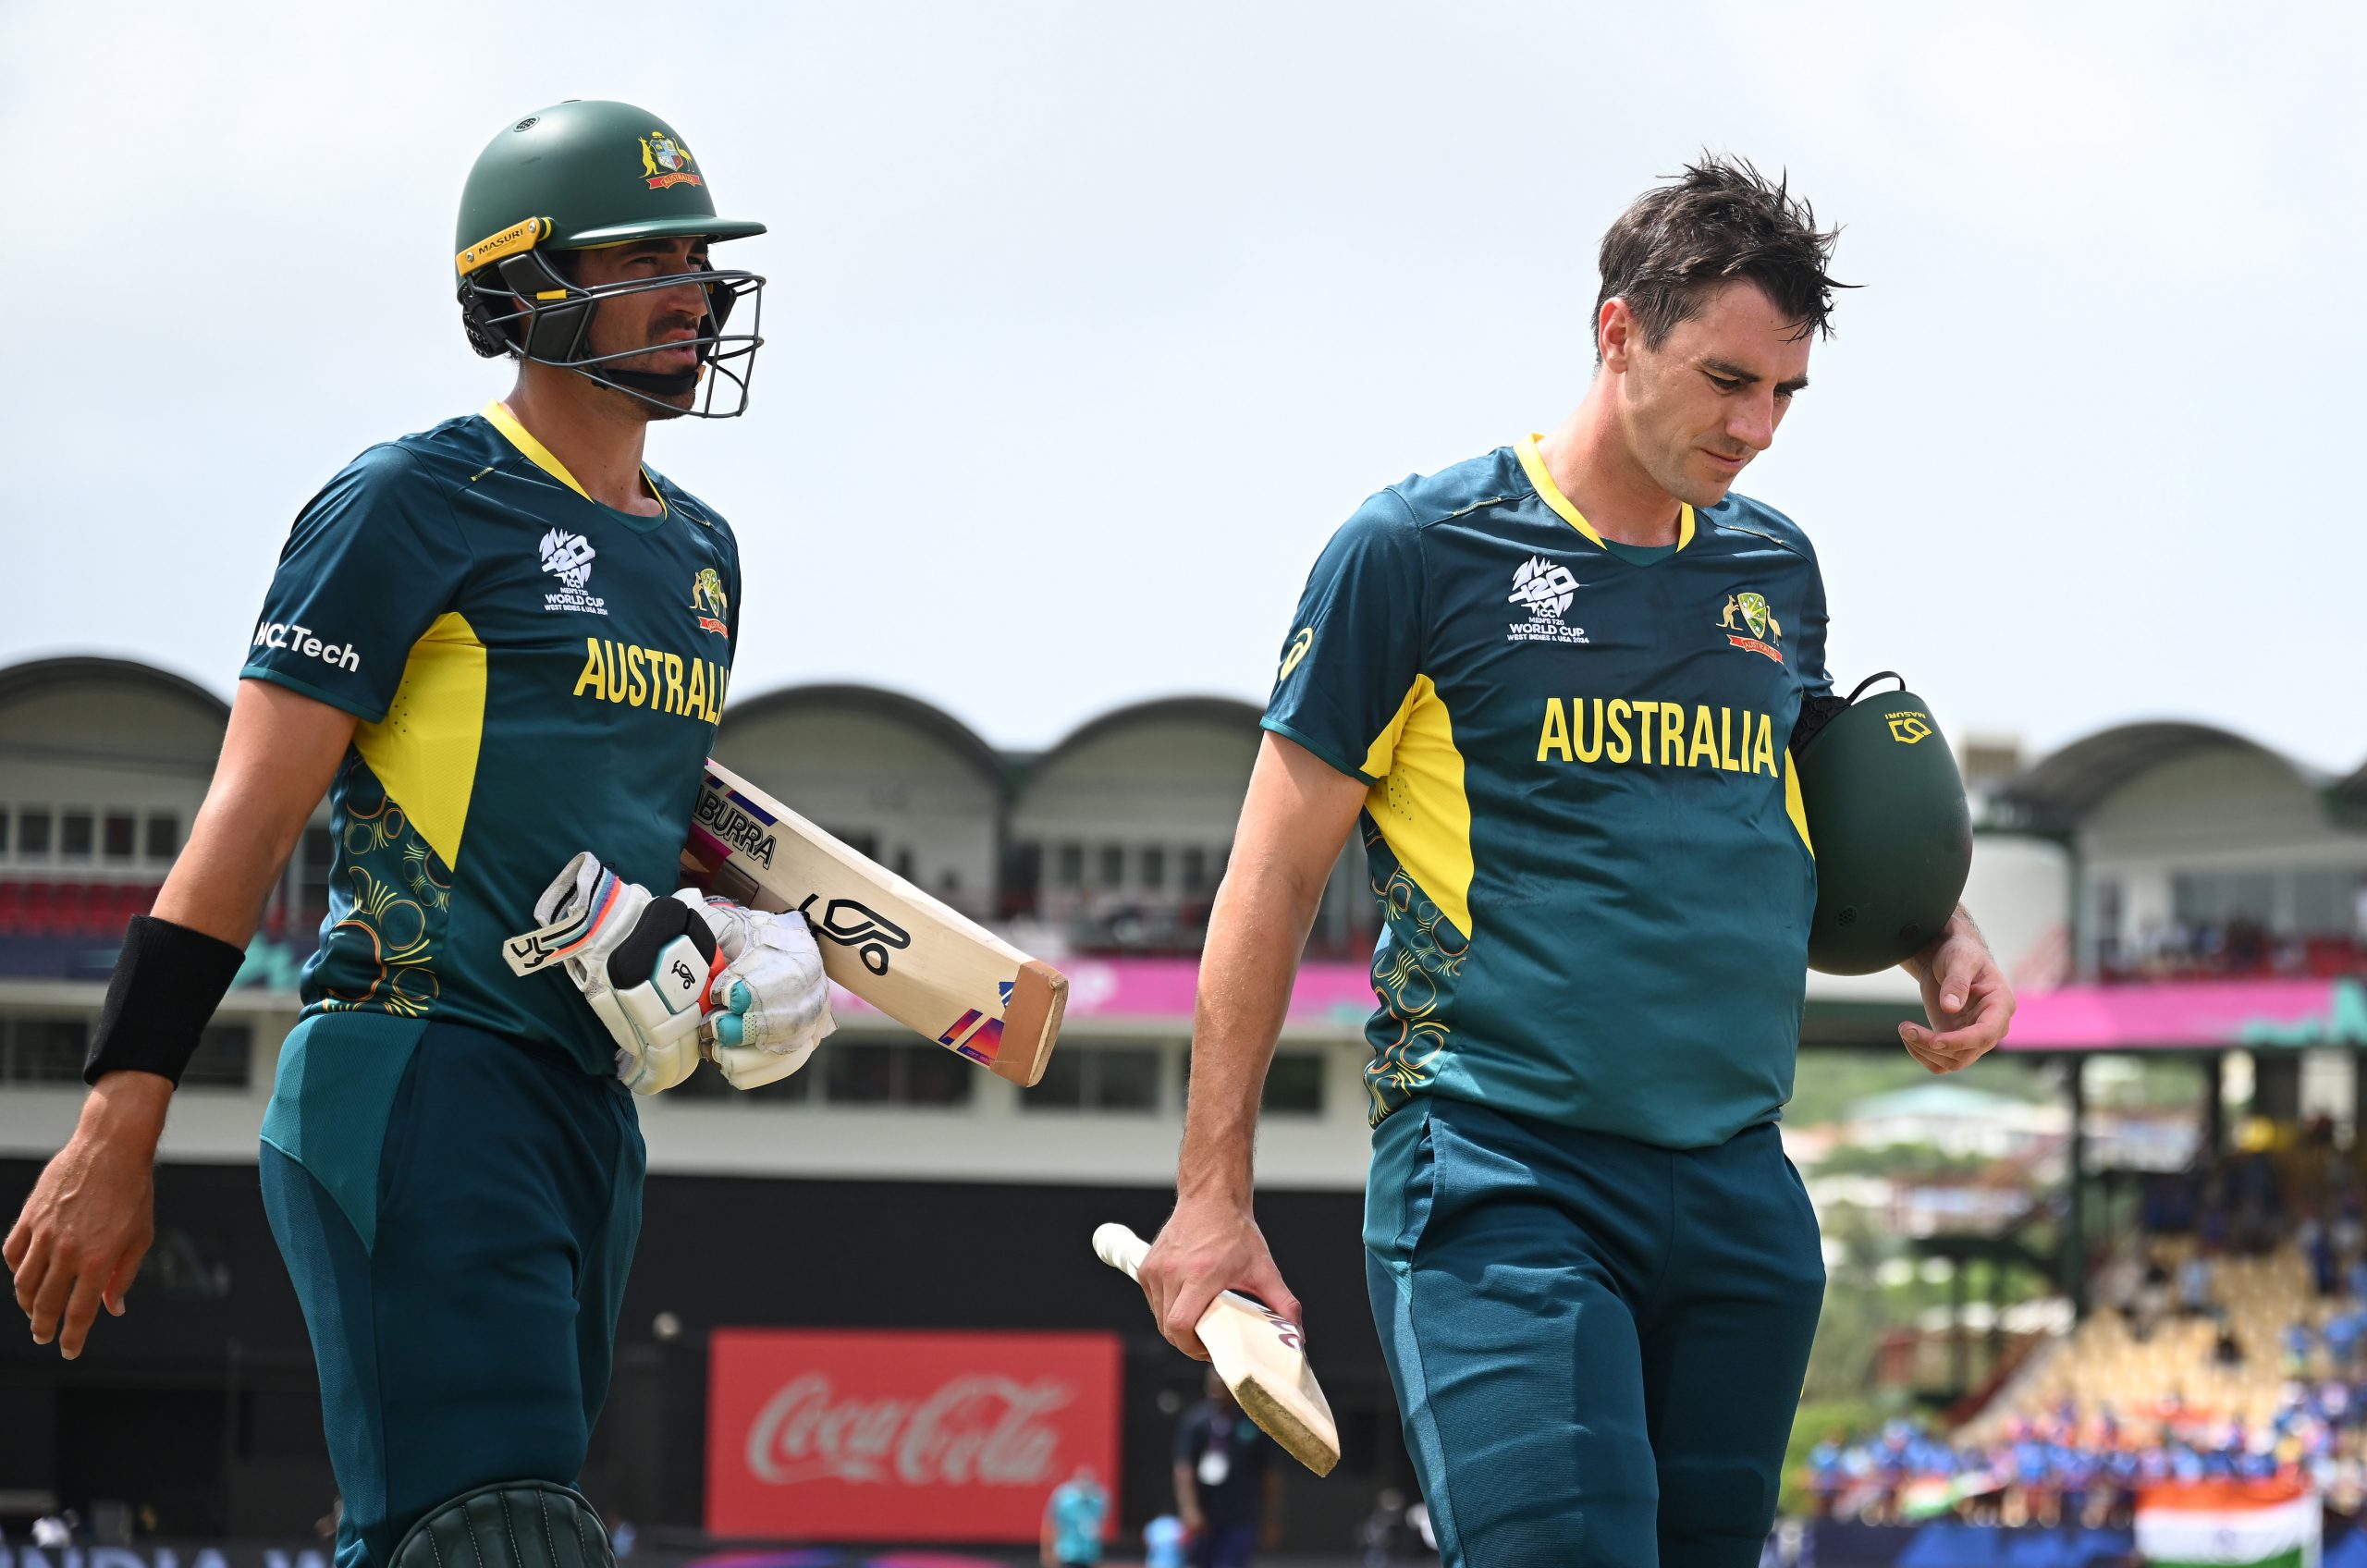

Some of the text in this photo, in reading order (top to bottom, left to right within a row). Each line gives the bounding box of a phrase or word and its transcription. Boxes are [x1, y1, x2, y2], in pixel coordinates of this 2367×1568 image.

[478, 228, 524, 255] MASURI
[566, 578, 581, 589] ICC
[546, 594, 605, 607] WORLD CUP
[1537, 608, 1556, 619] ICC
[1528, 617, 1551, 625] MEN'S
[1509, 623, 1585, 637] WORLD CUP
[1744, 641, 1779, 660] AUSTRALIA
[572, 637, 730, 726] AUSTRALI
[1884, 711, 1927, 720] MASURI
[1536, 697, 1779, 778] AUSTRALIA
